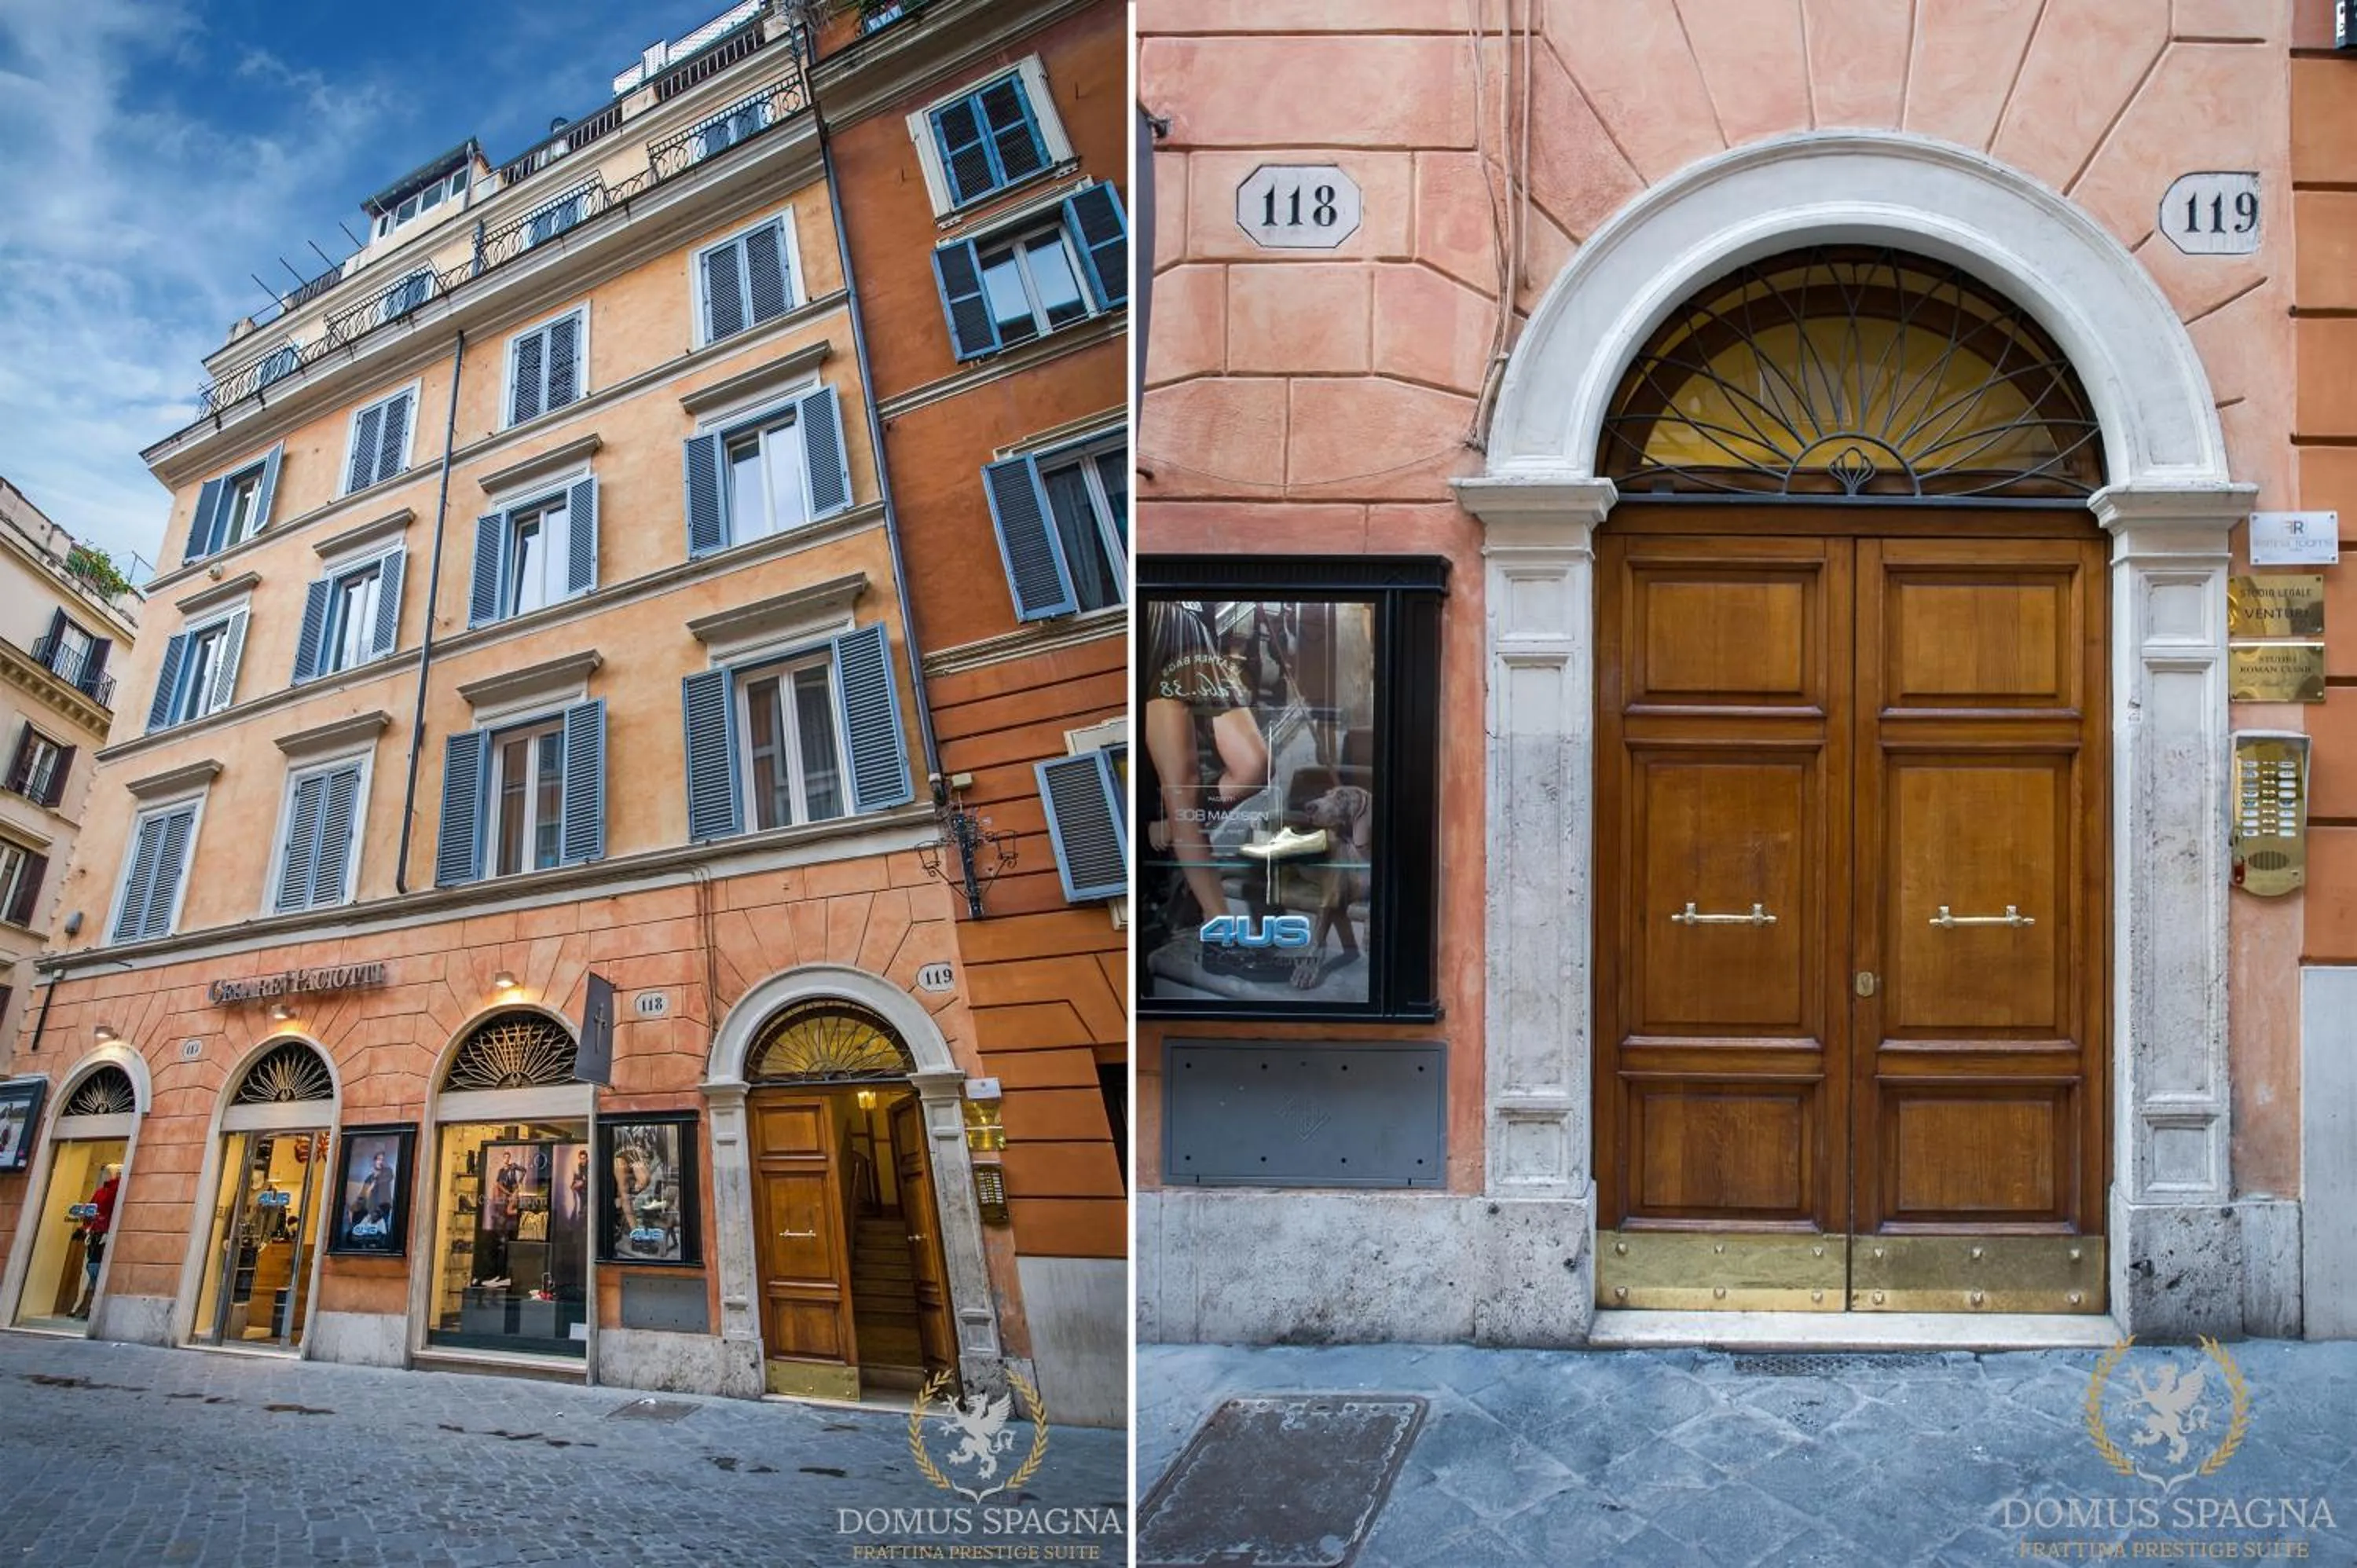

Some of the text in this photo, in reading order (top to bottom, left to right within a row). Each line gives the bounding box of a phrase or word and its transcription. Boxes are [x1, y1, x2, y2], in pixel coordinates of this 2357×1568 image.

[1262, 184, 1338, 227] 118
[2184, 192, 2258, 233] 119
[2278, 587, 2311, 597] LEGALE
[1200, 915, 1311, 947] 4US
[926, 968, 953, 985] 119
[642, 997, 663, 1012] 118
